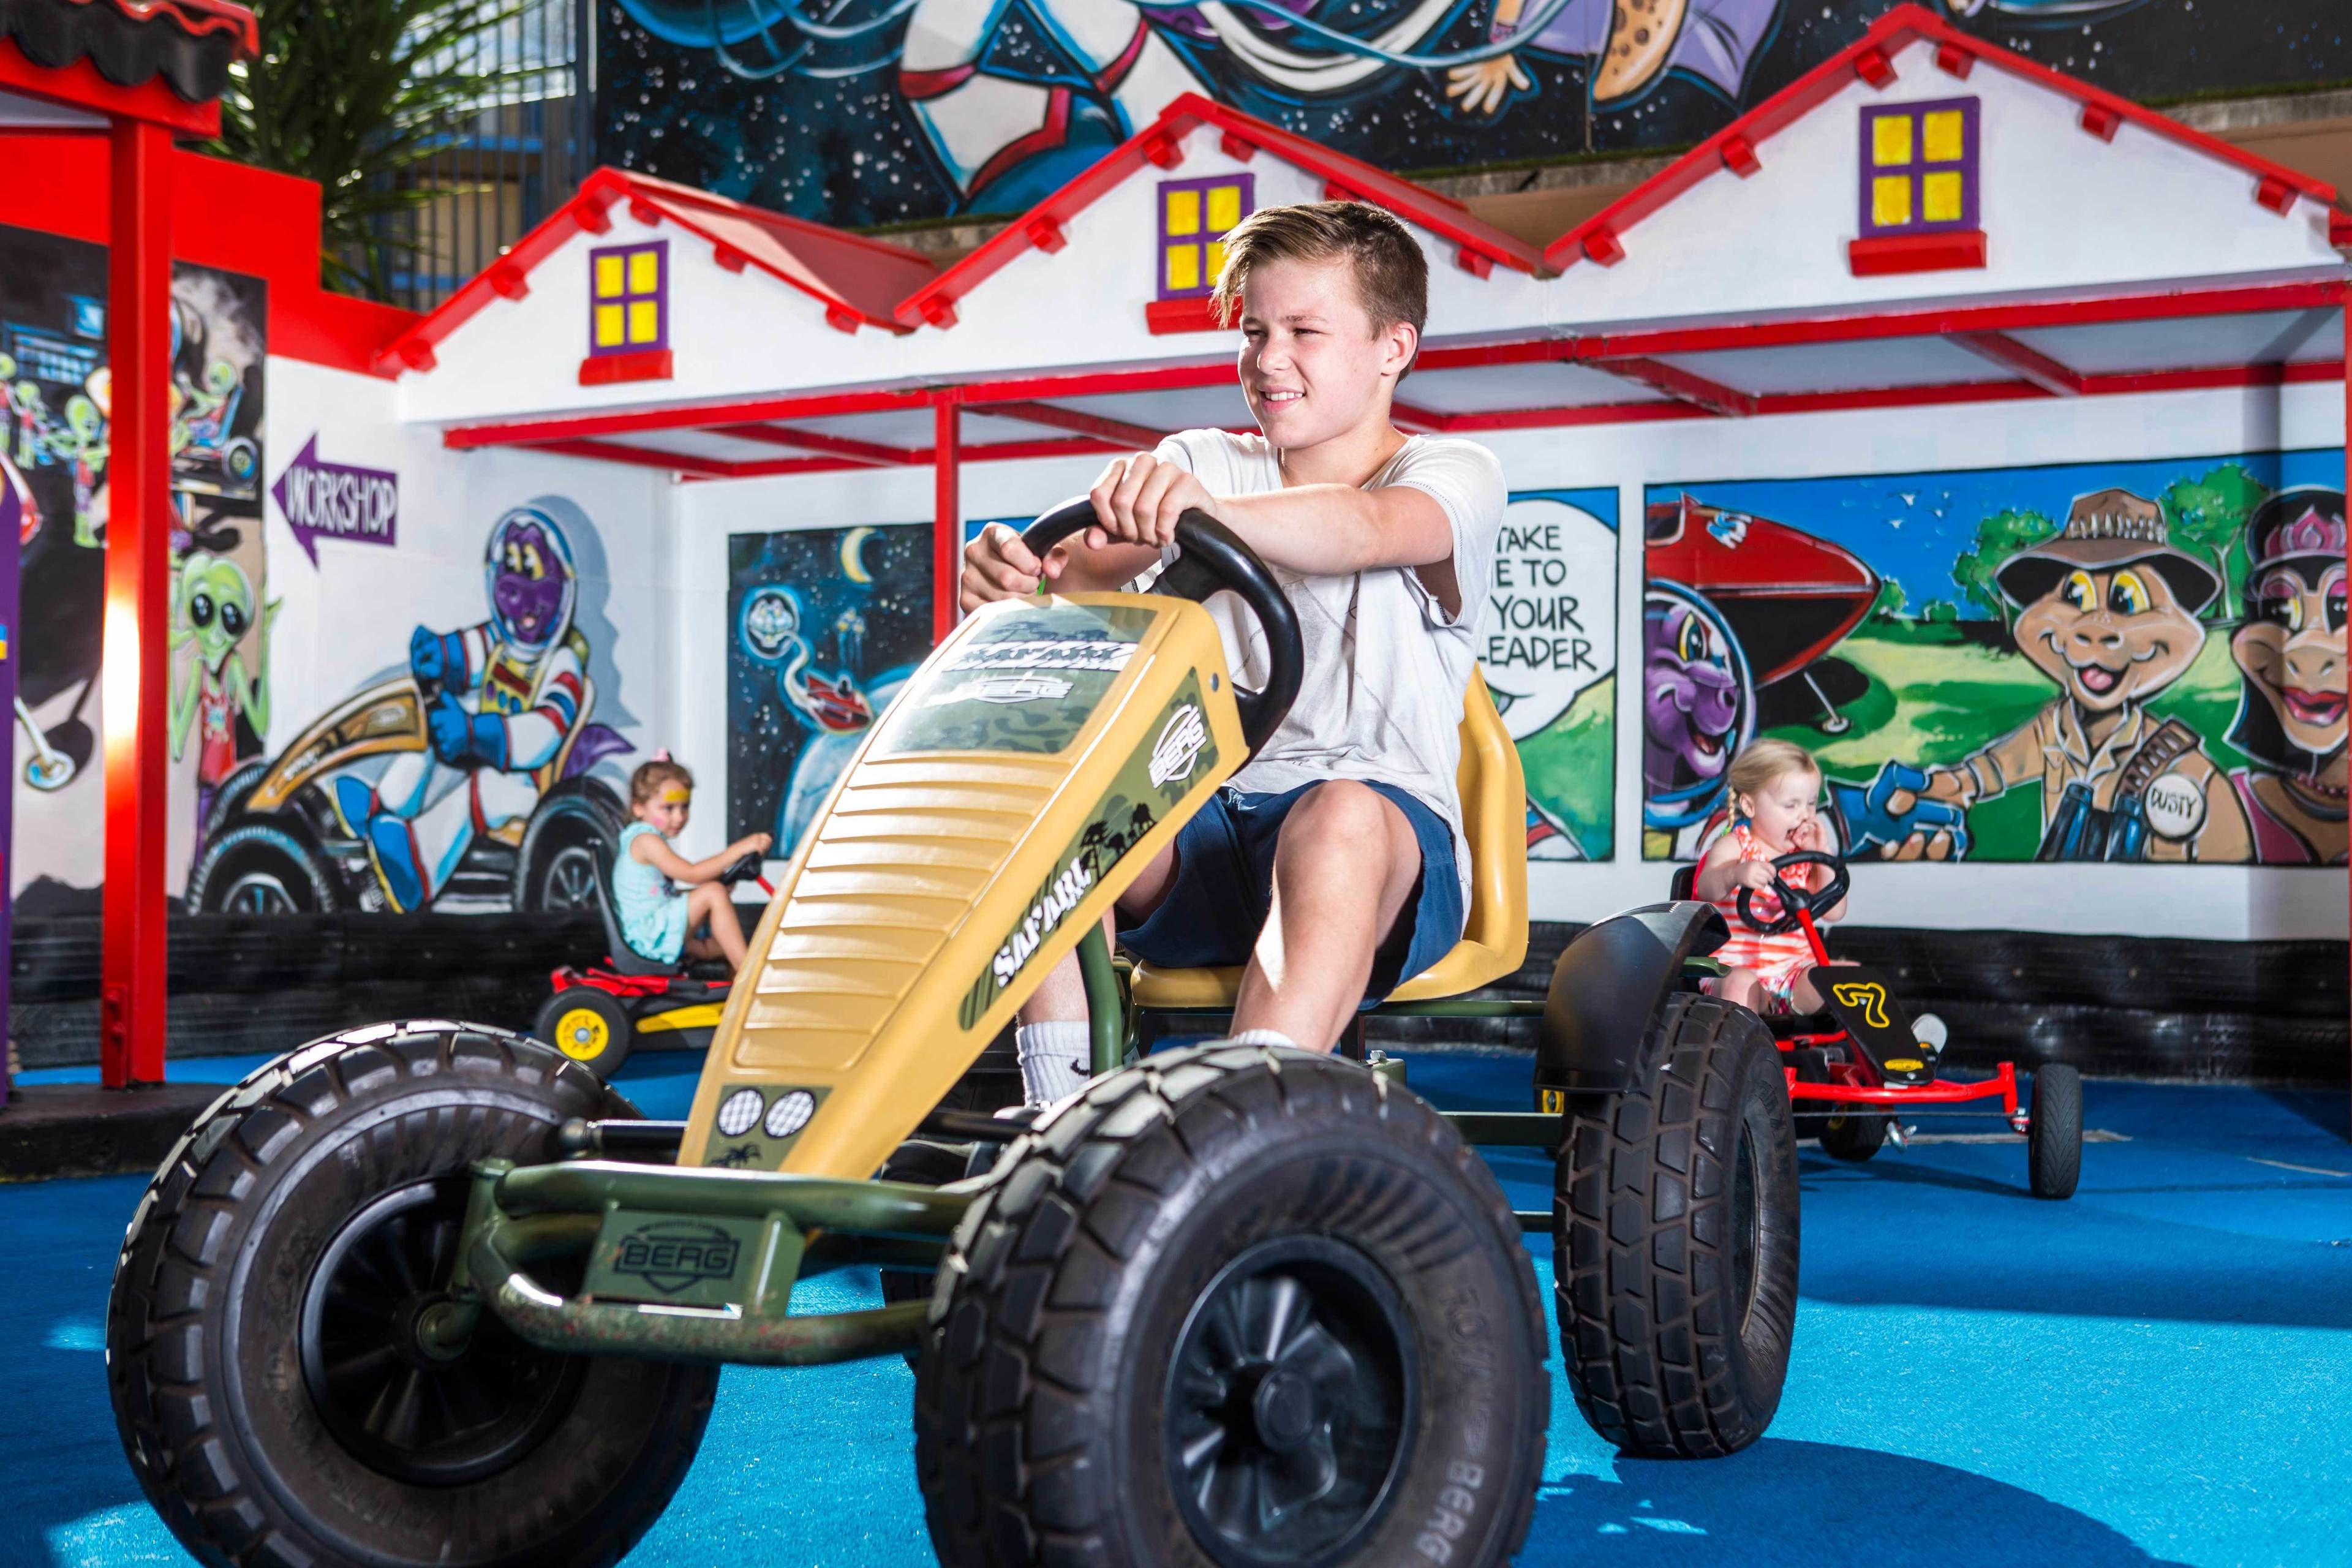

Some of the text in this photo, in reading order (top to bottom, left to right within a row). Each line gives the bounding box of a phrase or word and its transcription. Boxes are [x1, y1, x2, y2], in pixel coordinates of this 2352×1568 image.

[284, 466, 397, 537] WORKSHOP
[1496, 525, 1562, 552] TAKE
[1496, 559, 1566, 587] E TO
[1490, 595, 1585, 633] YOUR
[2150, 788, 2198, 819] DUSTY
[993, 856, 1092, 988] SAFARI
[1833, 982, 1890, 1028] 7
[624, 1243, 730, 1270] BERG
[1415, 1458, 1485, 1566] BERG
